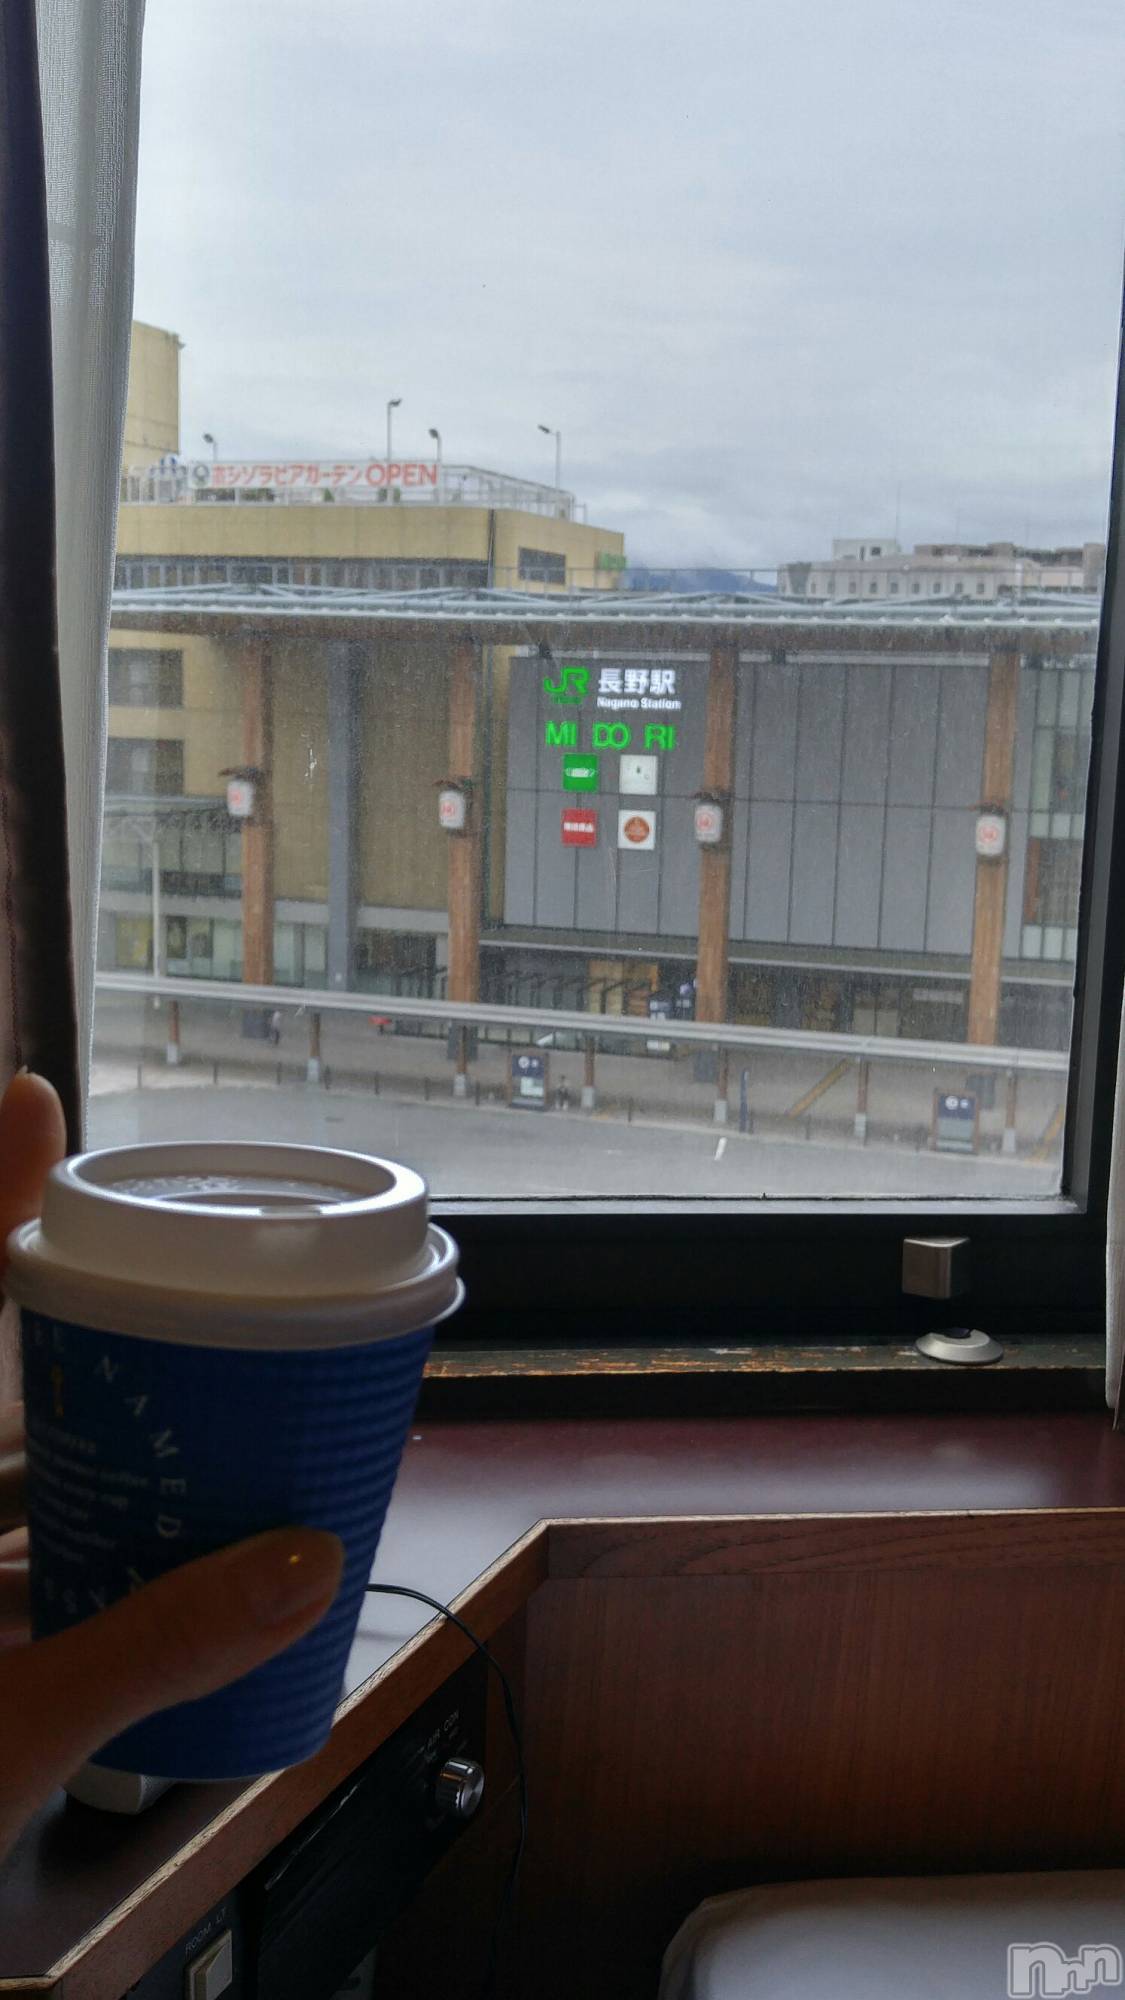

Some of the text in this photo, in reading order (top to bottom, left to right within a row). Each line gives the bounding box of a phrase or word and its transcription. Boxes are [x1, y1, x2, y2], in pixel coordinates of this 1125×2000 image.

[365, 462, 438, 487] OPEN
[543, 666, 590, 695] JR
[598, 667, 676, 695] 長野駅
[597, 696, 639, 711] Nagano
[640, 697, 681, 712] Station
[545, 720, 675, 749] MI DO RI
